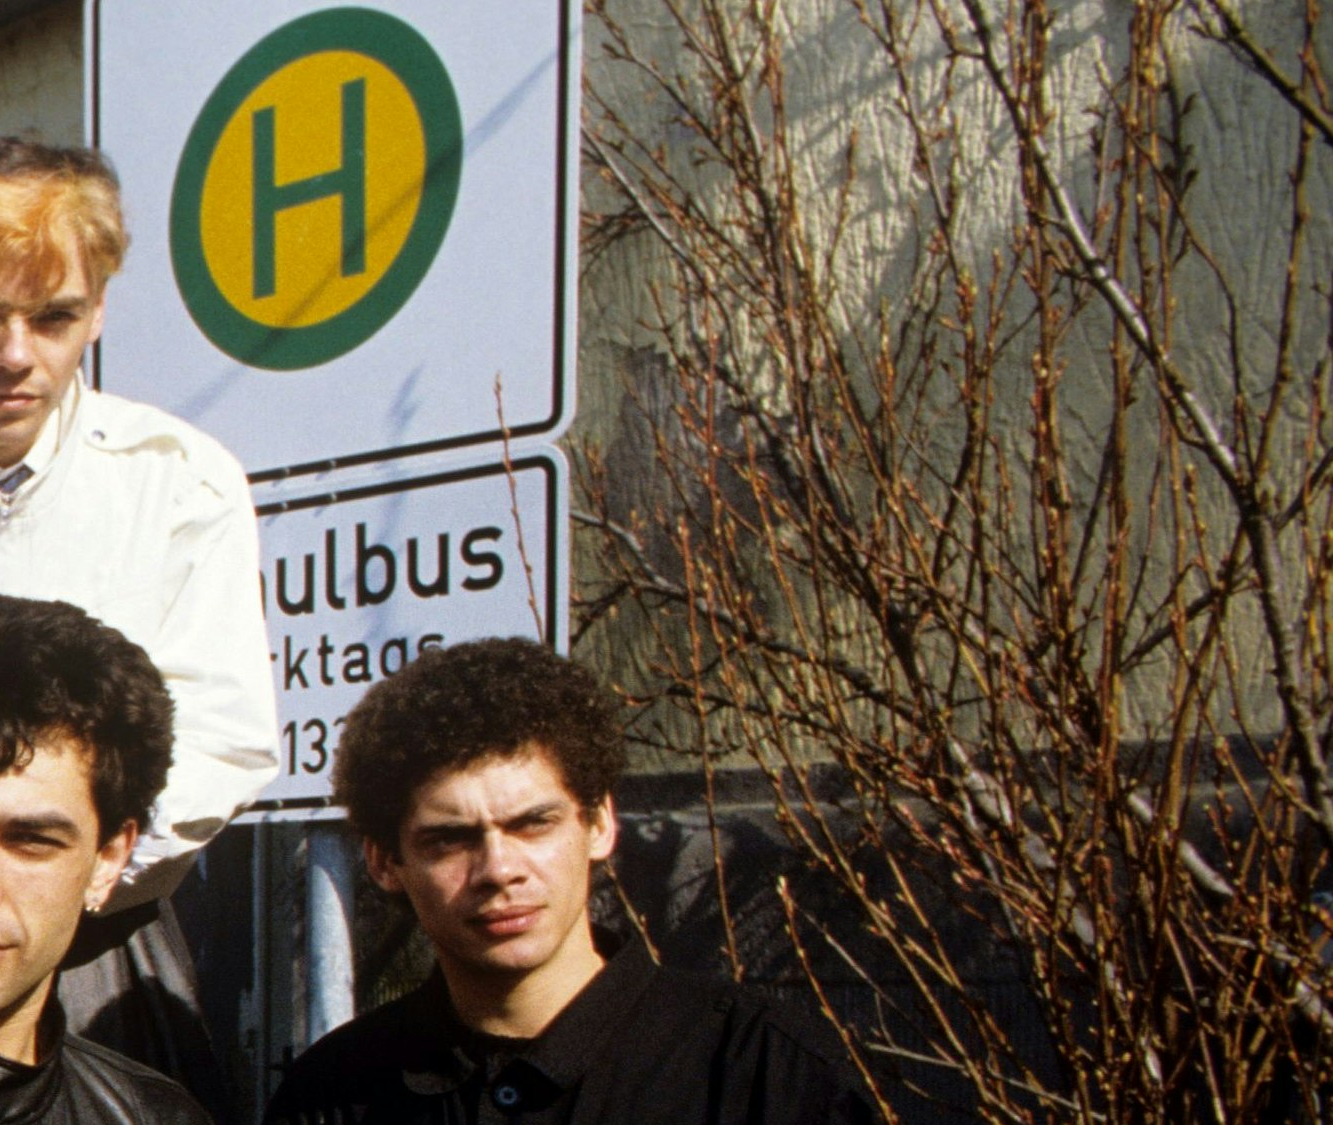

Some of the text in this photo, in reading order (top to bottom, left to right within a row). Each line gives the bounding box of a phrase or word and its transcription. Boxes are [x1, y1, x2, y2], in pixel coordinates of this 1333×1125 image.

[253, 77, 366, 300] H
[260, 522, 504, 620] ulbus
[284, 717, 346, 776] 13
